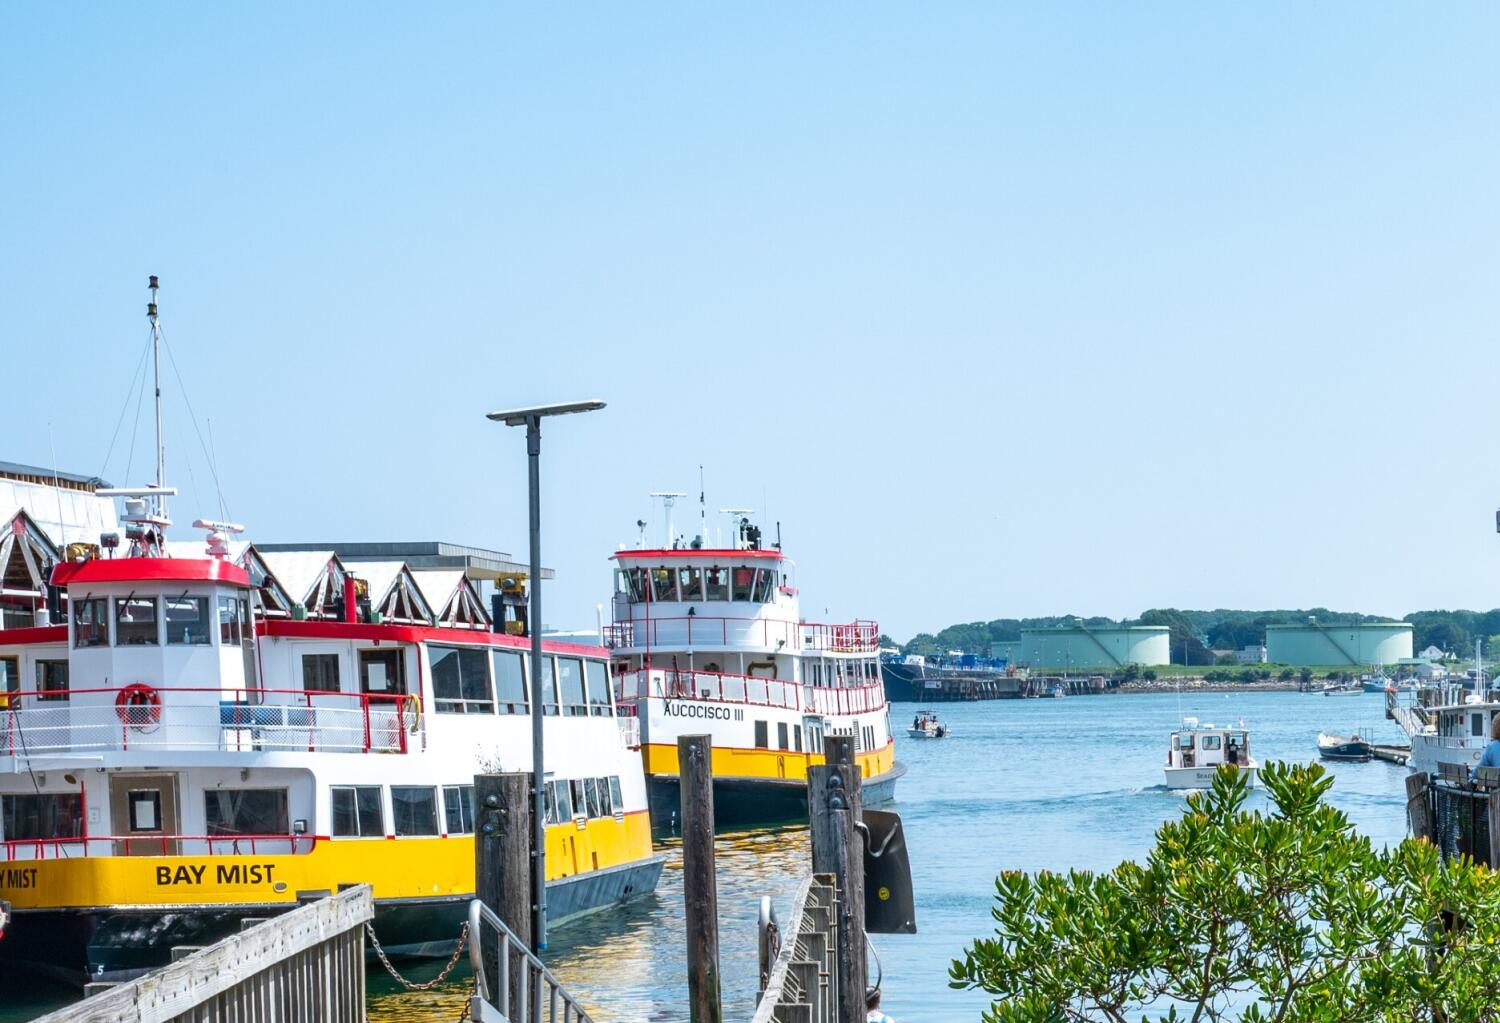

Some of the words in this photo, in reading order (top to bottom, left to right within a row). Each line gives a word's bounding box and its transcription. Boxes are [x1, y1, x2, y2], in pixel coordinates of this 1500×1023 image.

[663, 701, 731, 720] AUCOCISCO
[734, 708, 744, 721] III
[7, 868, 38, 889] MIST
[156, 865, 207, 885] BAY
[216, 864, 275, 884] MIST
[97, 964, 105, 976] 5
